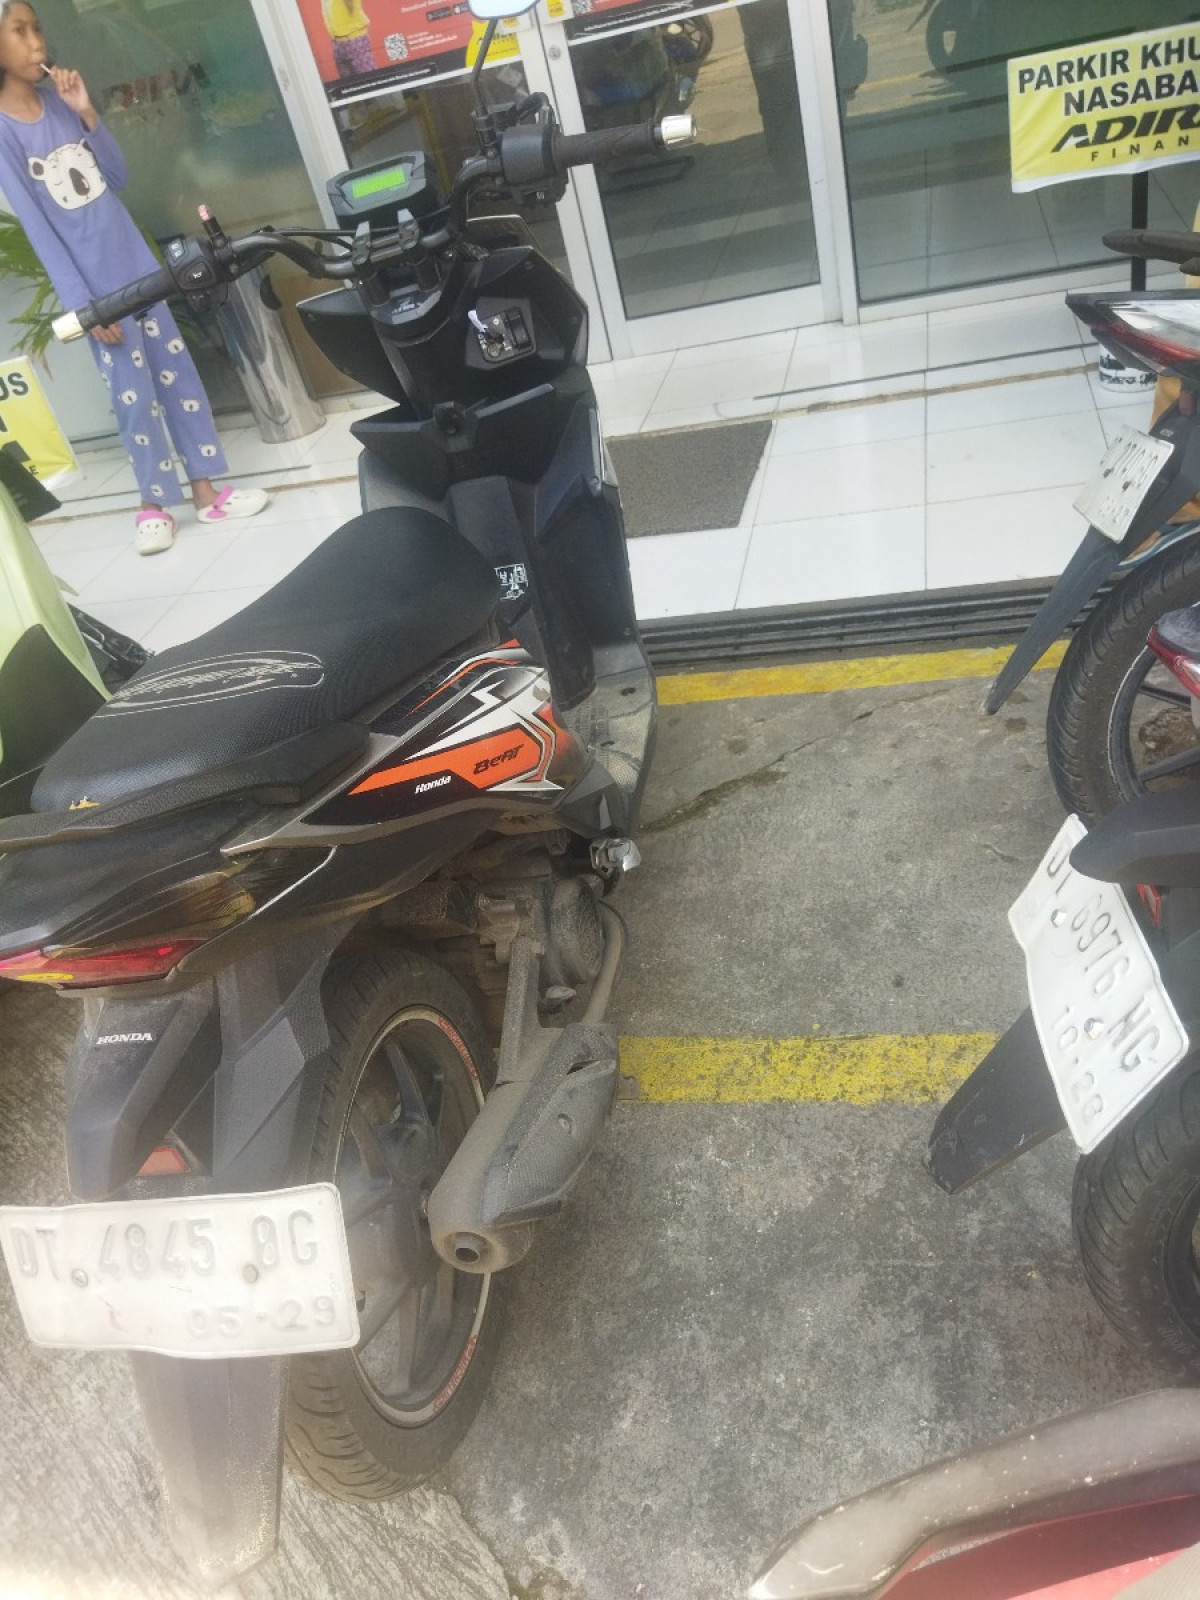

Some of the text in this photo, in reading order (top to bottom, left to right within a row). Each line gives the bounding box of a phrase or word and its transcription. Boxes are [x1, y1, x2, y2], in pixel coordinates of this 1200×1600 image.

[1018, 49, 1130, 93] PARKIR
[1064, 69, 1199, 116] NASABA
[414, 775, 452, 794] Honda
[1071, 892, 1130, 995] 6976
[1107, 996, 1161, 1073] NG
[95, 1031, 153, 1045] HONDA
[10, 1224, 62, 1282] DT
[99, 1217, 217, 1280] 4845
